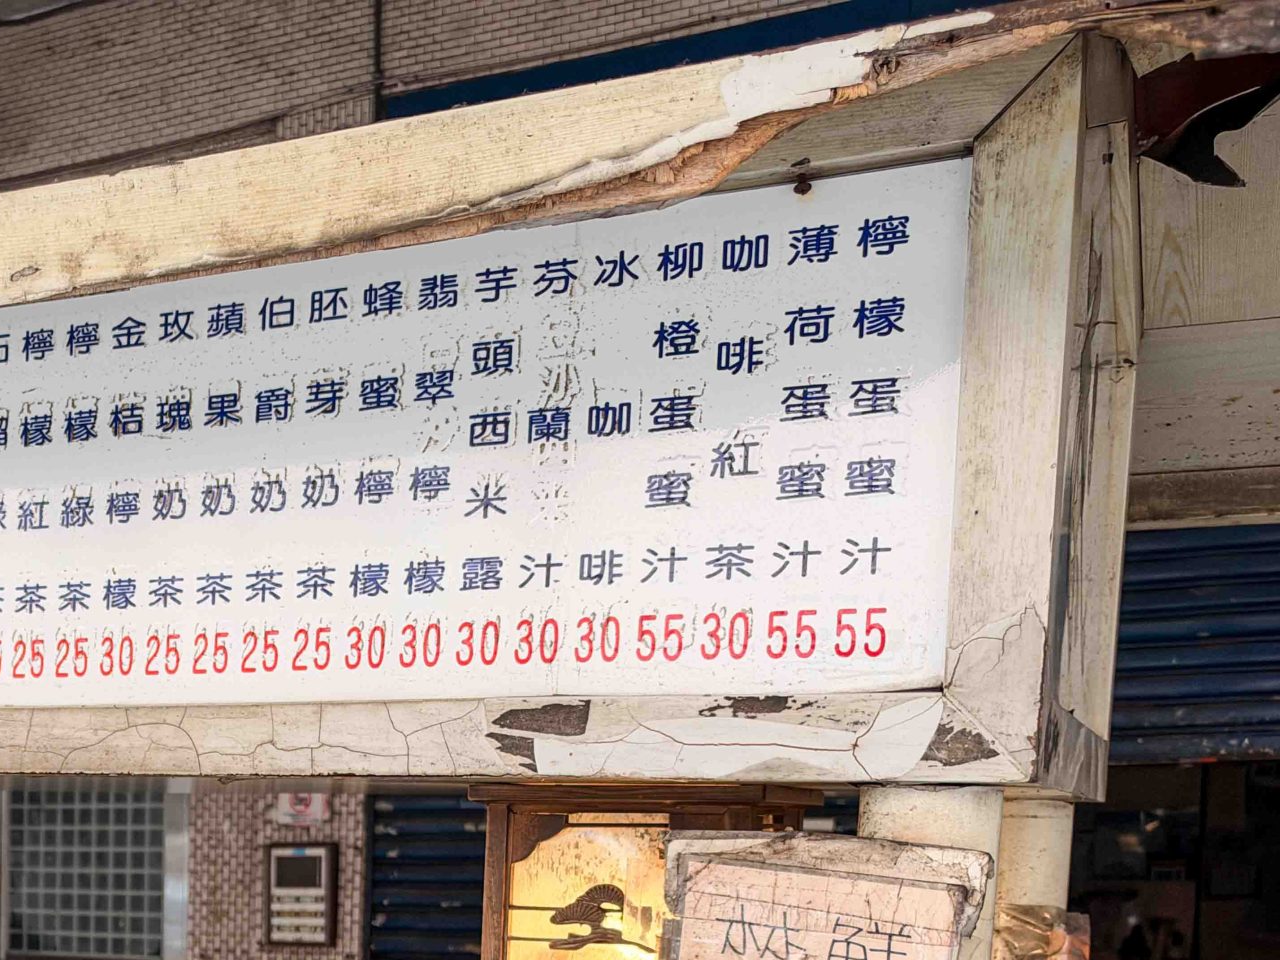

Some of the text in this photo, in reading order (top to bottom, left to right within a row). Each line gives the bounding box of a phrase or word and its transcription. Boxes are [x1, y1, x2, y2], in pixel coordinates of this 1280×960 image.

[12, 328, 55, 679] 檸檬紅茶 25
[55, 322, 100, 678] 檸檬綠茶 25
[99, 317, 147, 677] 金桔檸檬 30
[145, 310, 194, 676] 玫瑰奶茶 25
[192, 304, 244, 674] 蘋果奶茶 25
[241, 296, 295, 673] 伯爵奶茶 25
[292, 287, 349, 671] 胚芽奶茶 25
[344, 281, 403, 670] 蜂蜜檸檬 30
[399, 274, 458, 668] 翡翠檸檬 30
[456, 265, 518, 666] 芋頭西米露 30
[514, 257, 579, 665] 芬蘭汁 30
[574, 250, 640, 663] 冰咖啡 30
[636, 241, 704, 662] 柳橙蛋蜜汁 55
[700, 234, 769, 660] 咖啡紅茶 30
[767, 225, 840, 659] 薄荷蛋蜜汁 55
[834, 215, 911, 658] 檸檬蛋蜜汁 55
